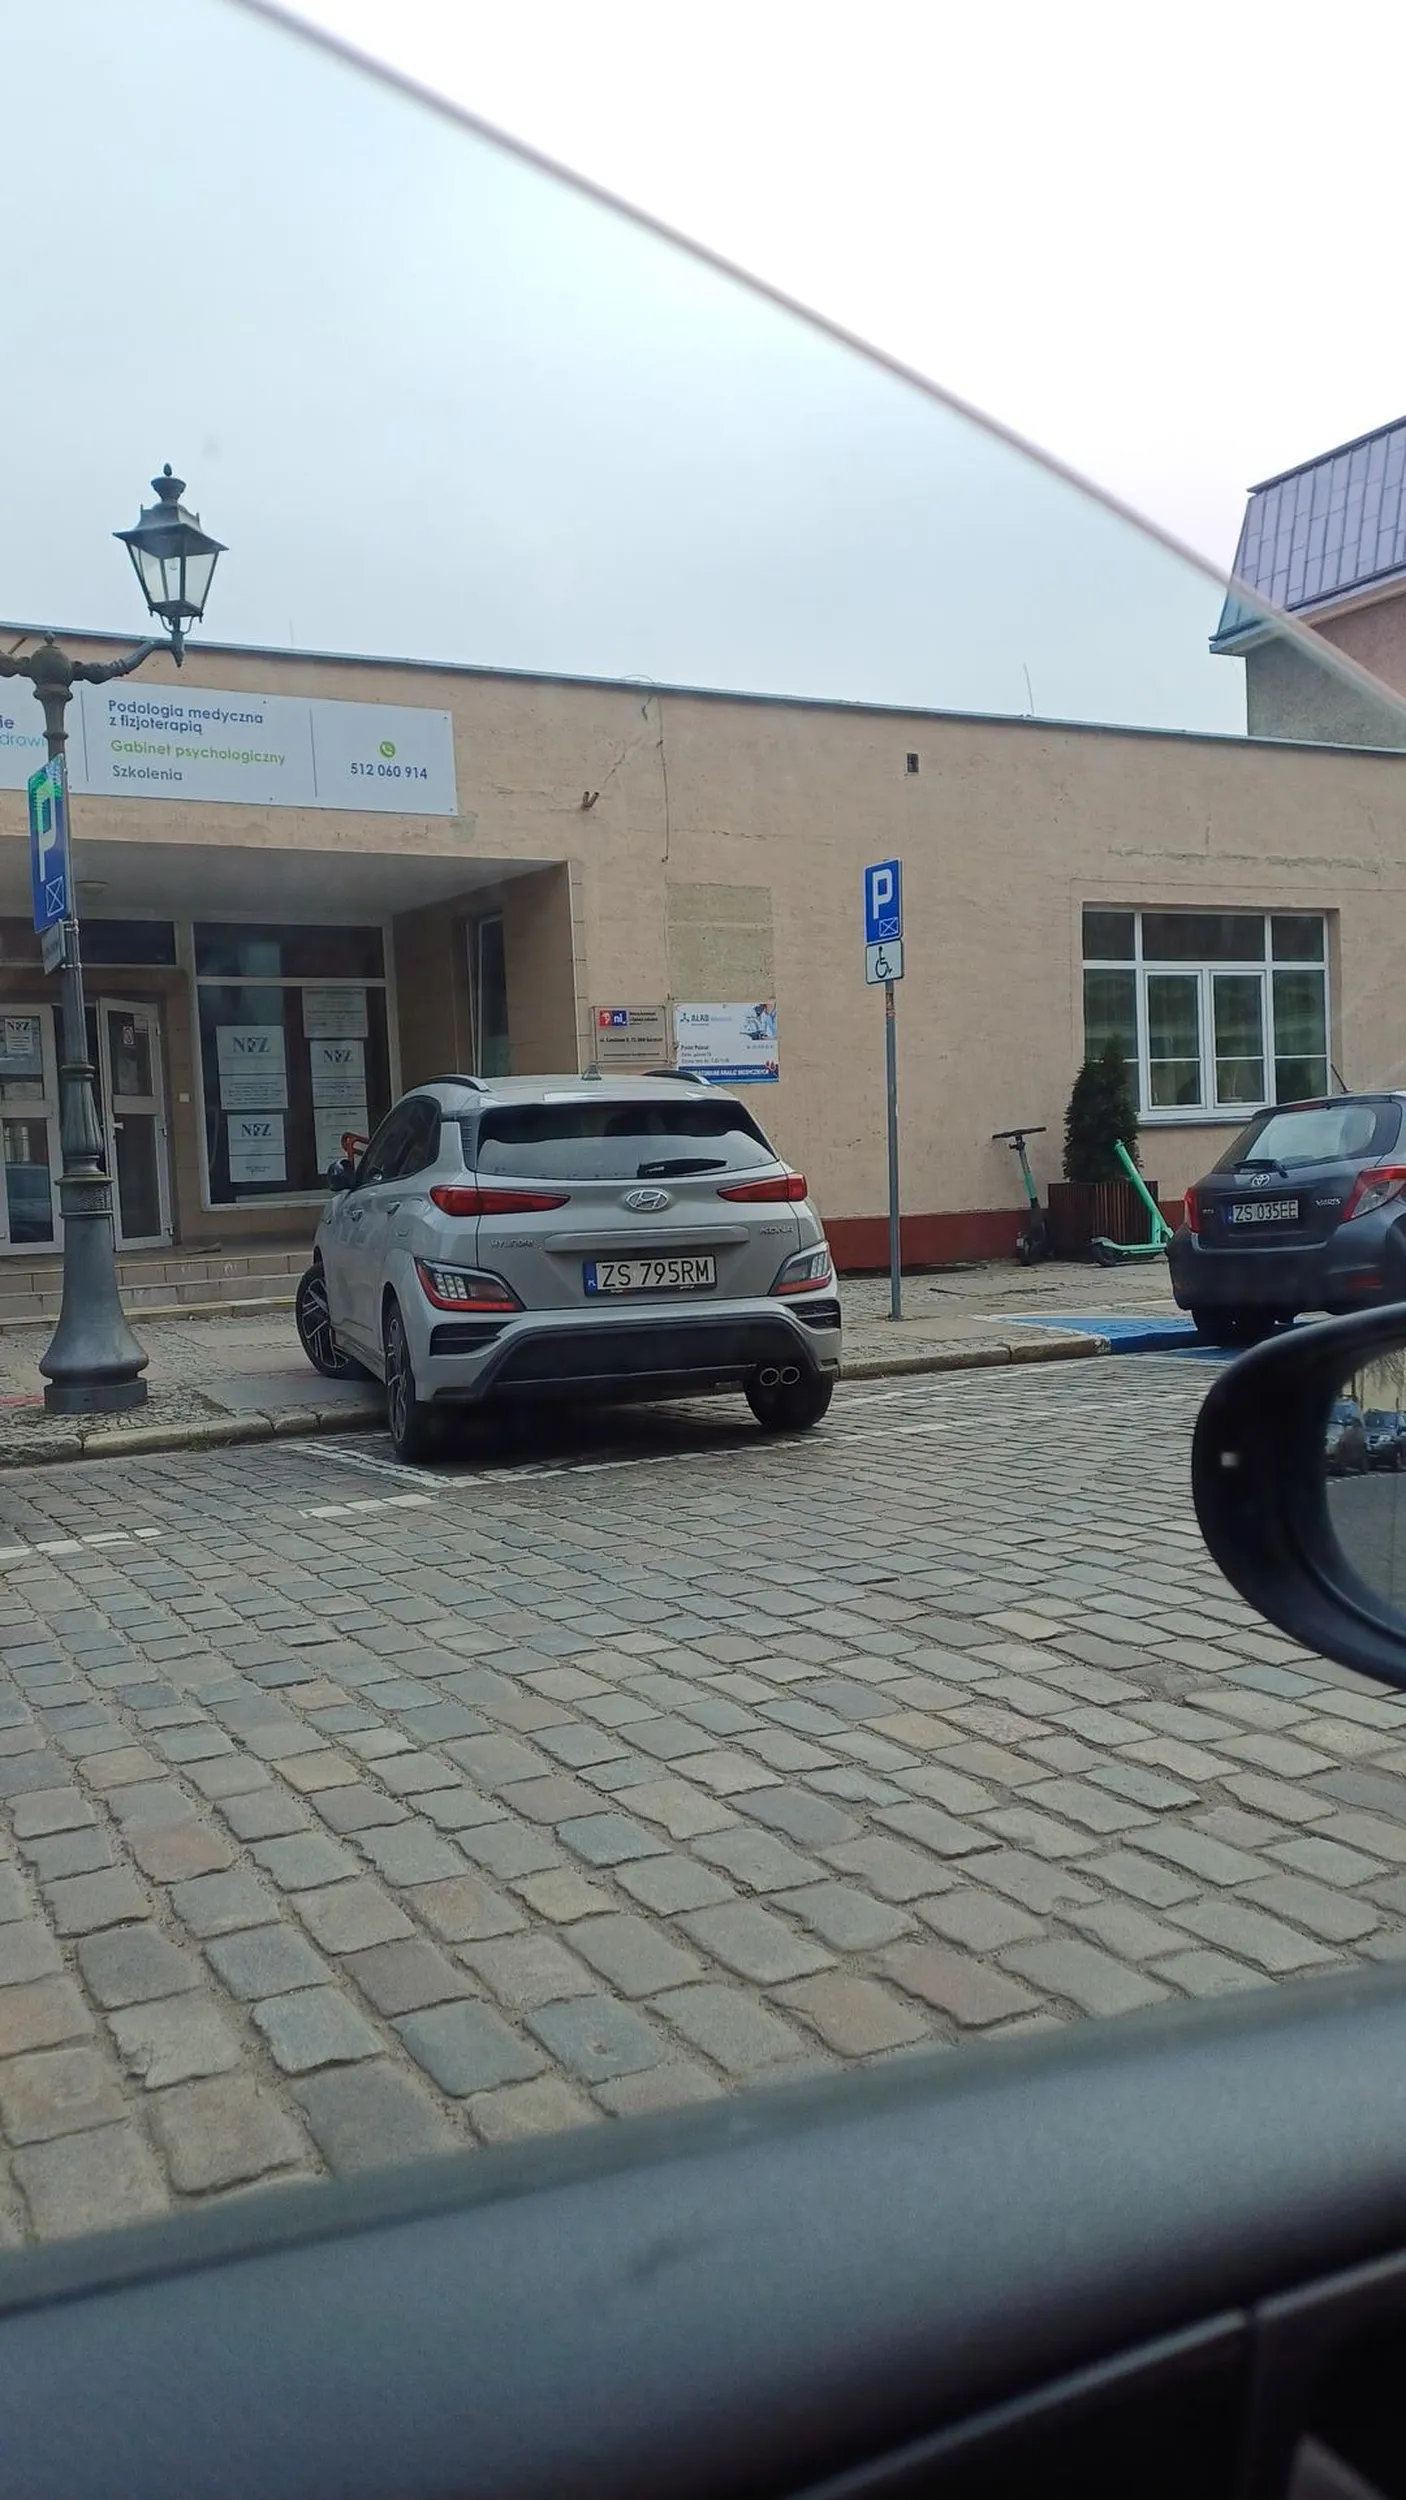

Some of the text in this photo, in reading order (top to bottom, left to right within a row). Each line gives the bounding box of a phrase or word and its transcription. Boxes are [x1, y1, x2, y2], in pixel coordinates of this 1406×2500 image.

[108, 699, 263, 724] Podologia medyczna
[109, 714, 203, 735] z fizjoterapią
[110, 739, 285, 766] Gabinet psychologiczny
[112, 764, 183, 781] Szkolenia
[350, 762, 428, 780] 512 060 914
[872, 868, 893, 920] P
[241, 1123, 271, 1137] NFZ
[1235, 1201, 1297, 1221] ZS 035EE
[601, 1259, 710, 1288] ZS 795RM
